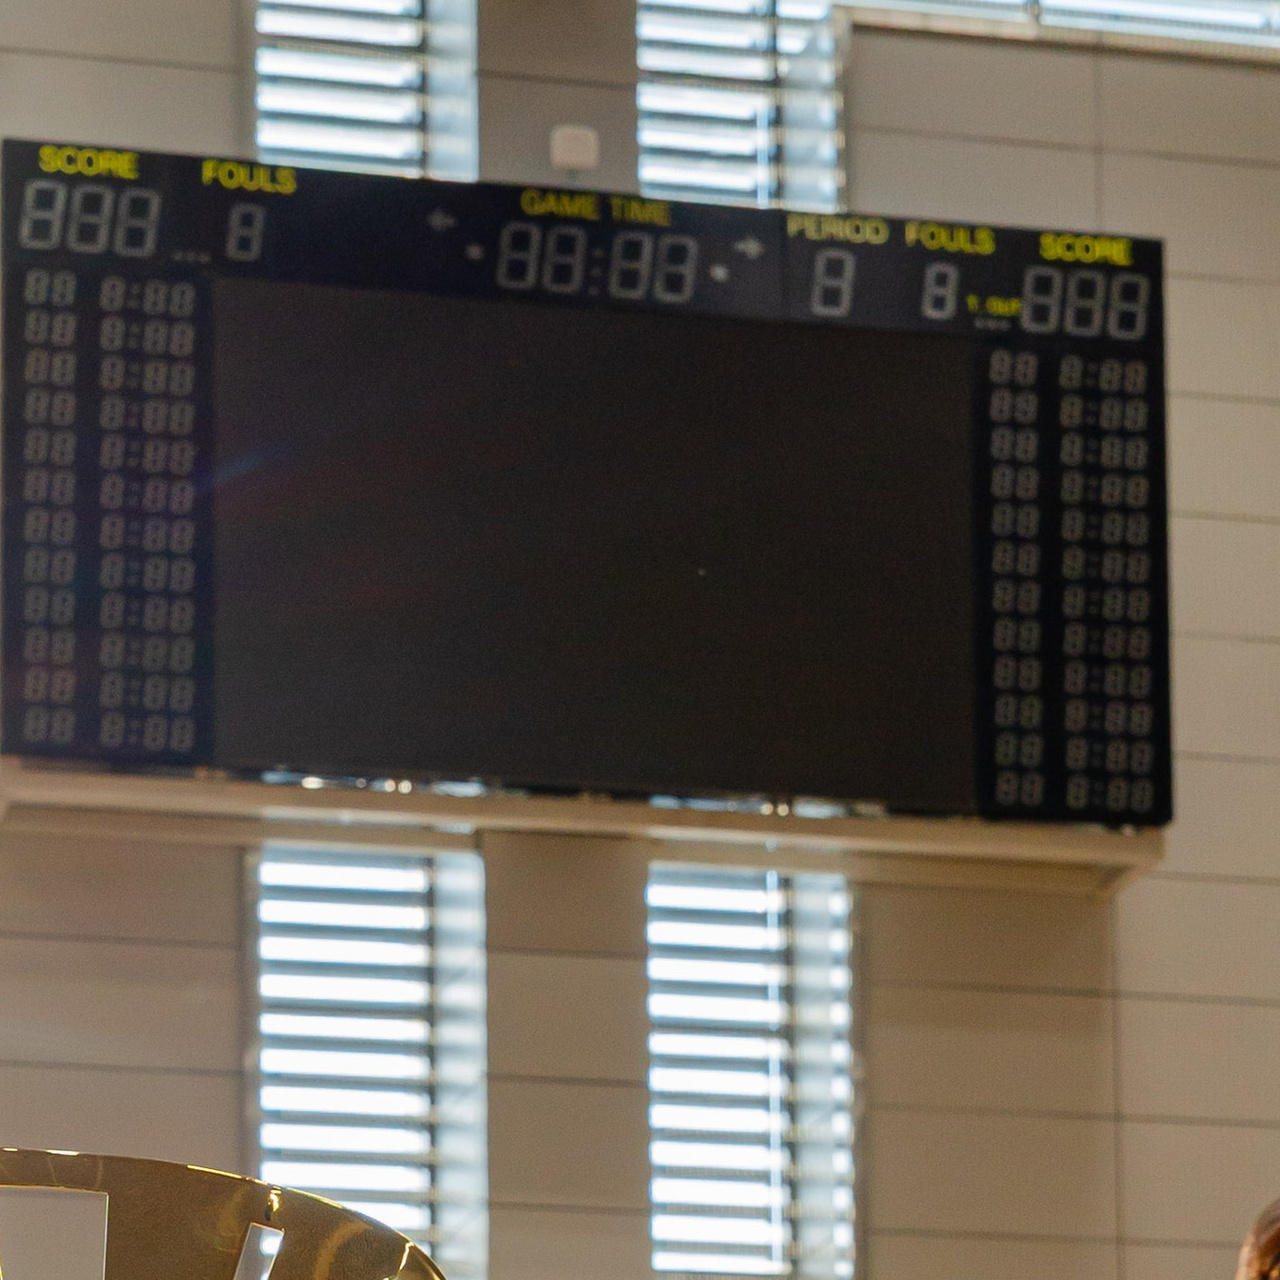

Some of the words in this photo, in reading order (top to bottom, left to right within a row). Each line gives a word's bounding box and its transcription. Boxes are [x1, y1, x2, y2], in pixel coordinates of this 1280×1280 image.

[38, 145, 139, 180] SCORE
[202, 159, 296, 194] FOULS
[521, 187, 598, 221] GAME
[611, 192, 672, 226] TIME
[787, 213, 889, 245] PERIOD
[906, 222, 996, 256] FOULS
[1040, 232, 1132, 266] SCORE
